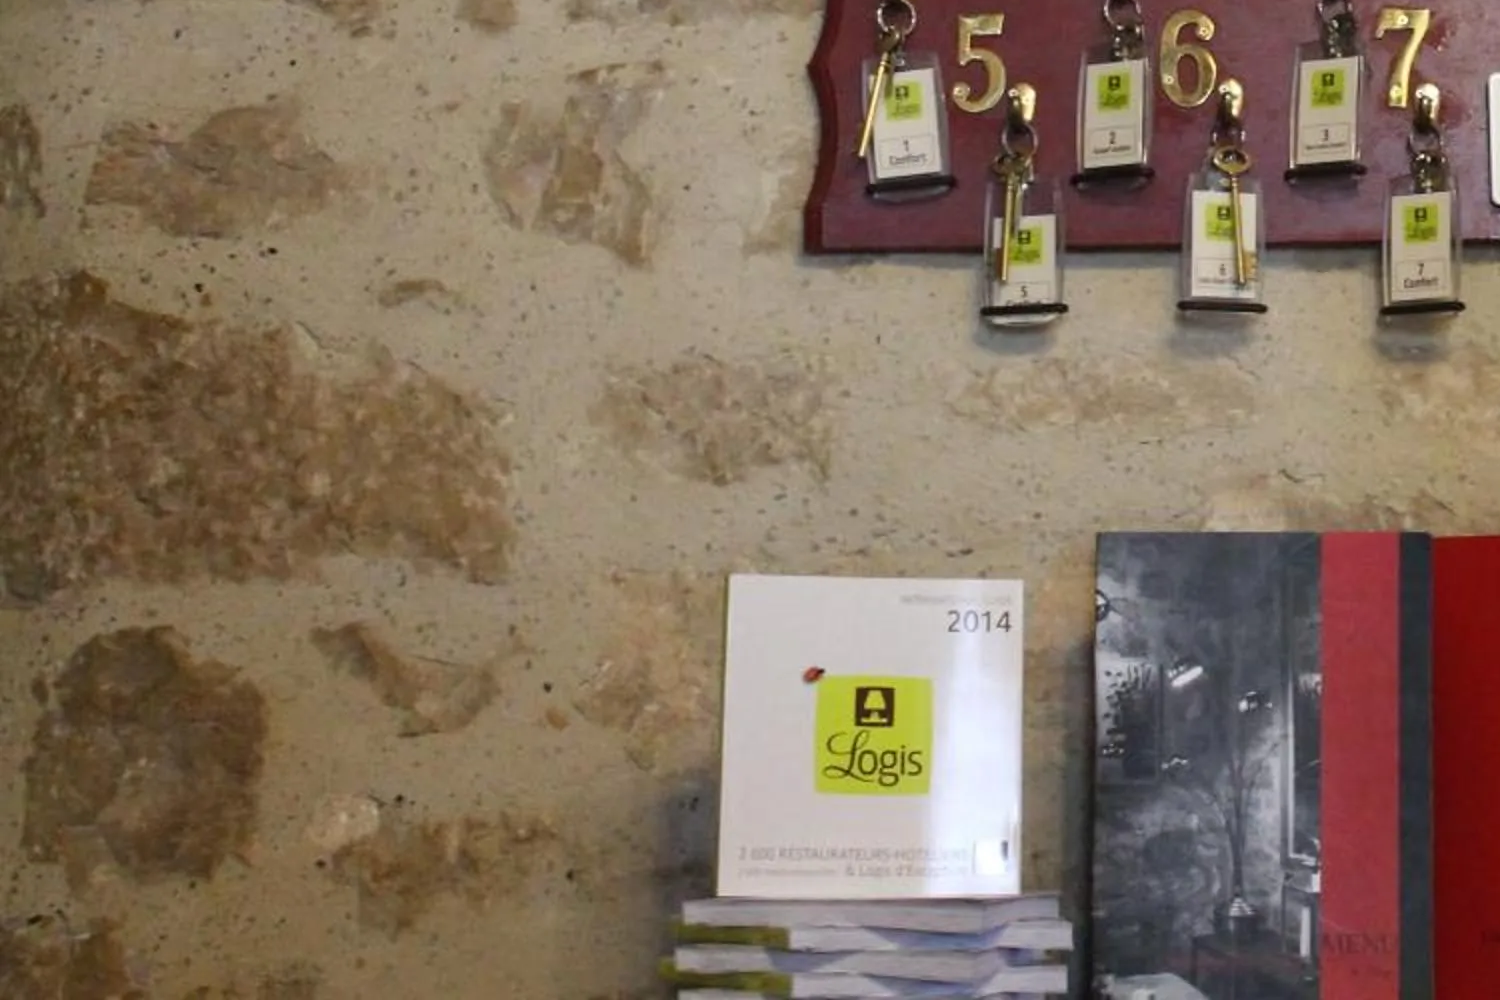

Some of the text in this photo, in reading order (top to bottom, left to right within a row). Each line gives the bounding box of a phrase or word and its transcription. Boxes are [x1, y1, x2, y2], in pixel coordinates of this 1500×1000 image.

[952, 12, 1007, 113] 5
[1159, 9, 1218, 108] 6
[1375, 8, 1431, 108] 7
[946, 609, 1013, 634] 2014
[822, 729, 924, 788] Logis
